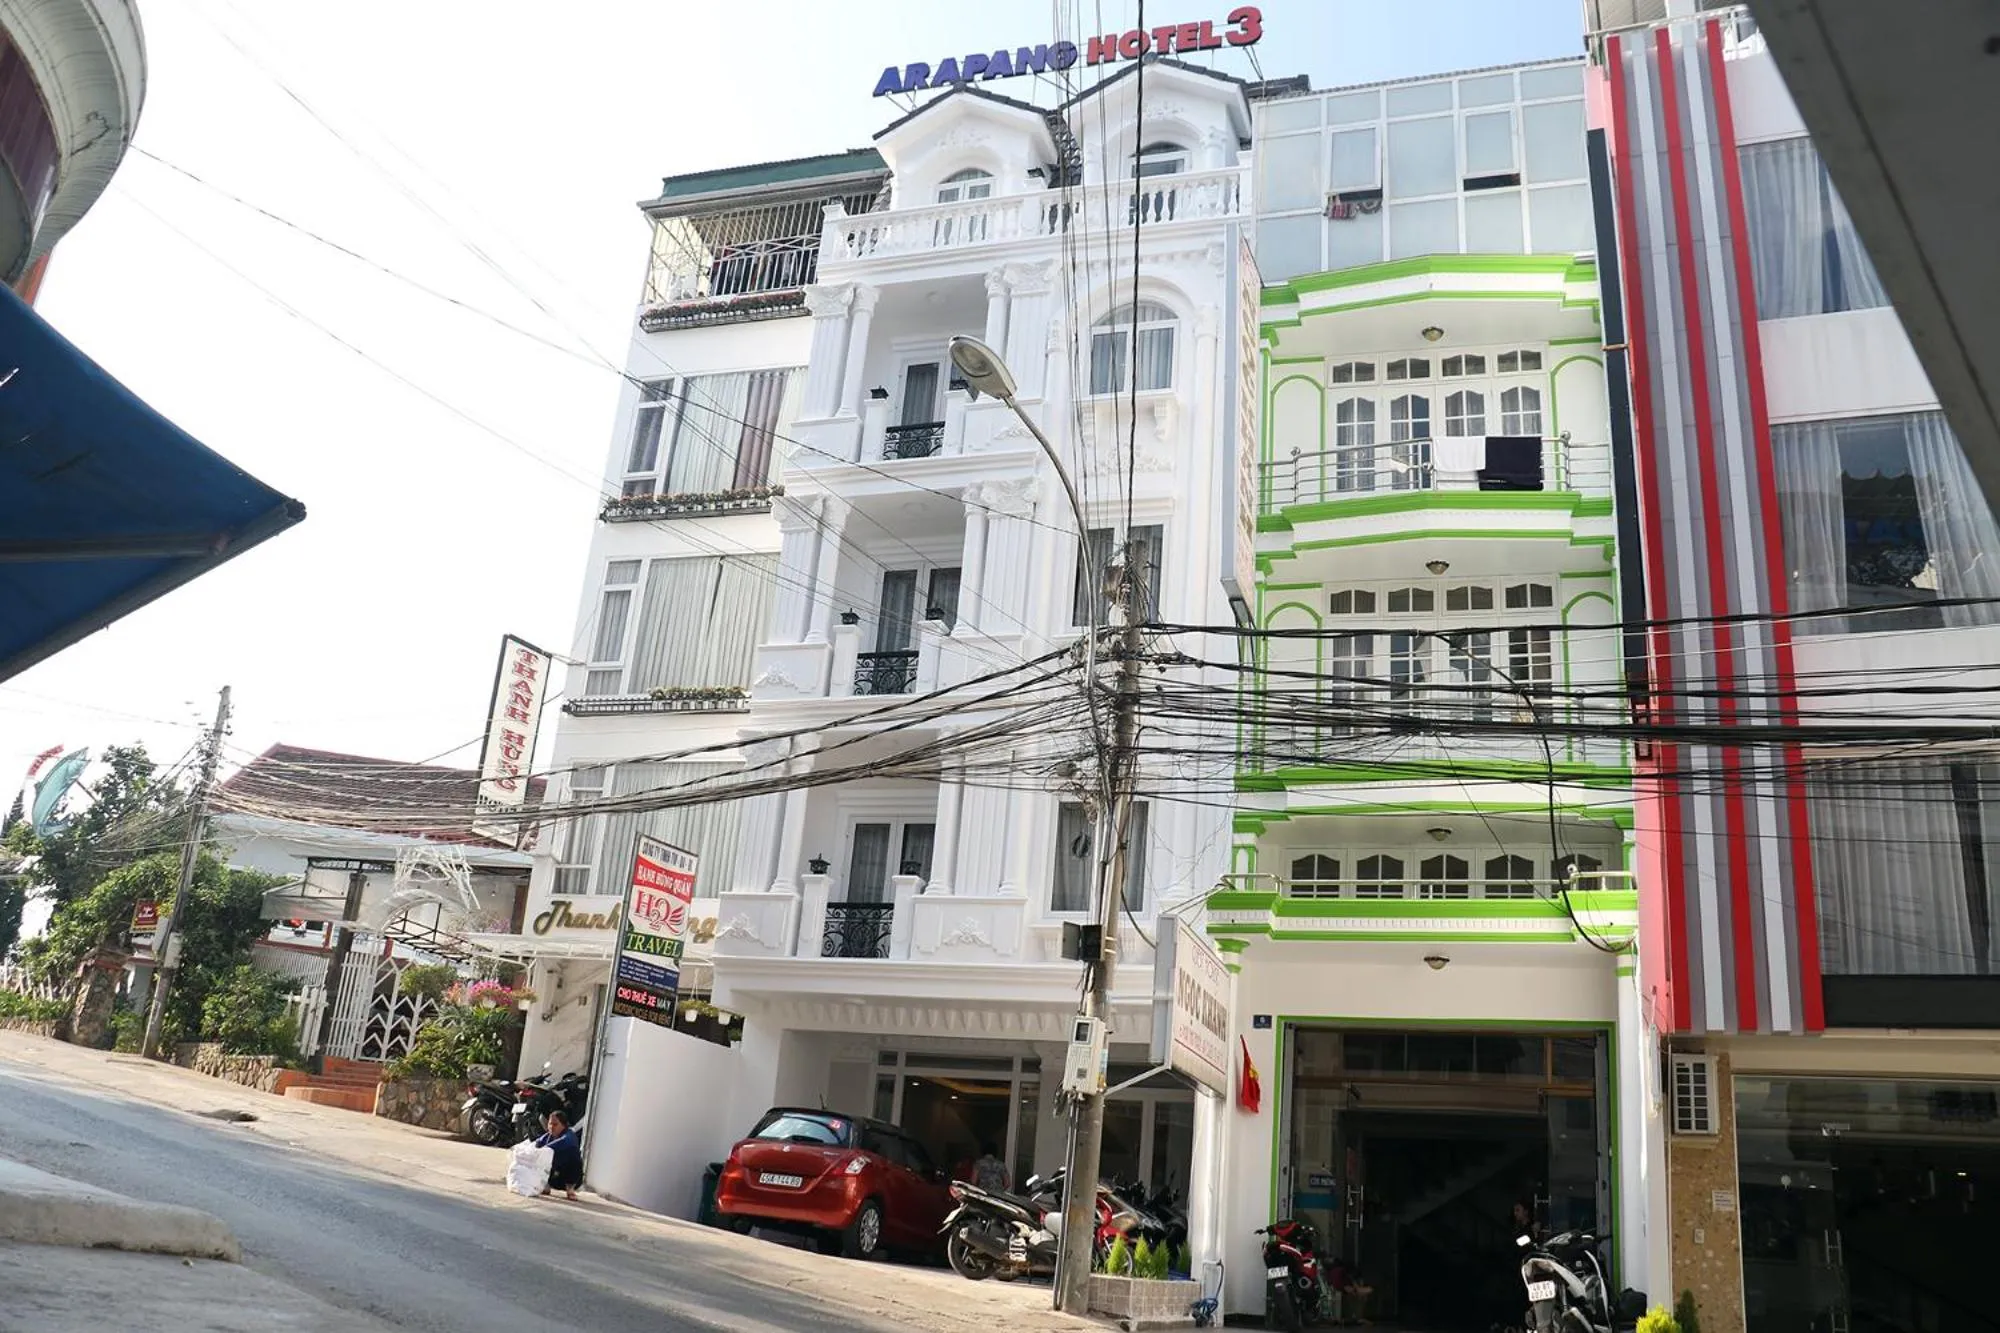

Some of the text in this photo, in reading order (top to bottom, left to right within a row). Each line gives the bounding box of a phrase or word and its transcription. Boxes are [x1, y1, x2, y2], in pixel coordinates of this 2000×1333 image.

[873, 6, 1263, 97] ARAPANG HOTEL 3
[506, 649, 539, 725] THANH
[627, 932, 682, 959] TRAVEL
[617, 985, 633, 1000] CHO
[646, 995, 657, 1008] XE
